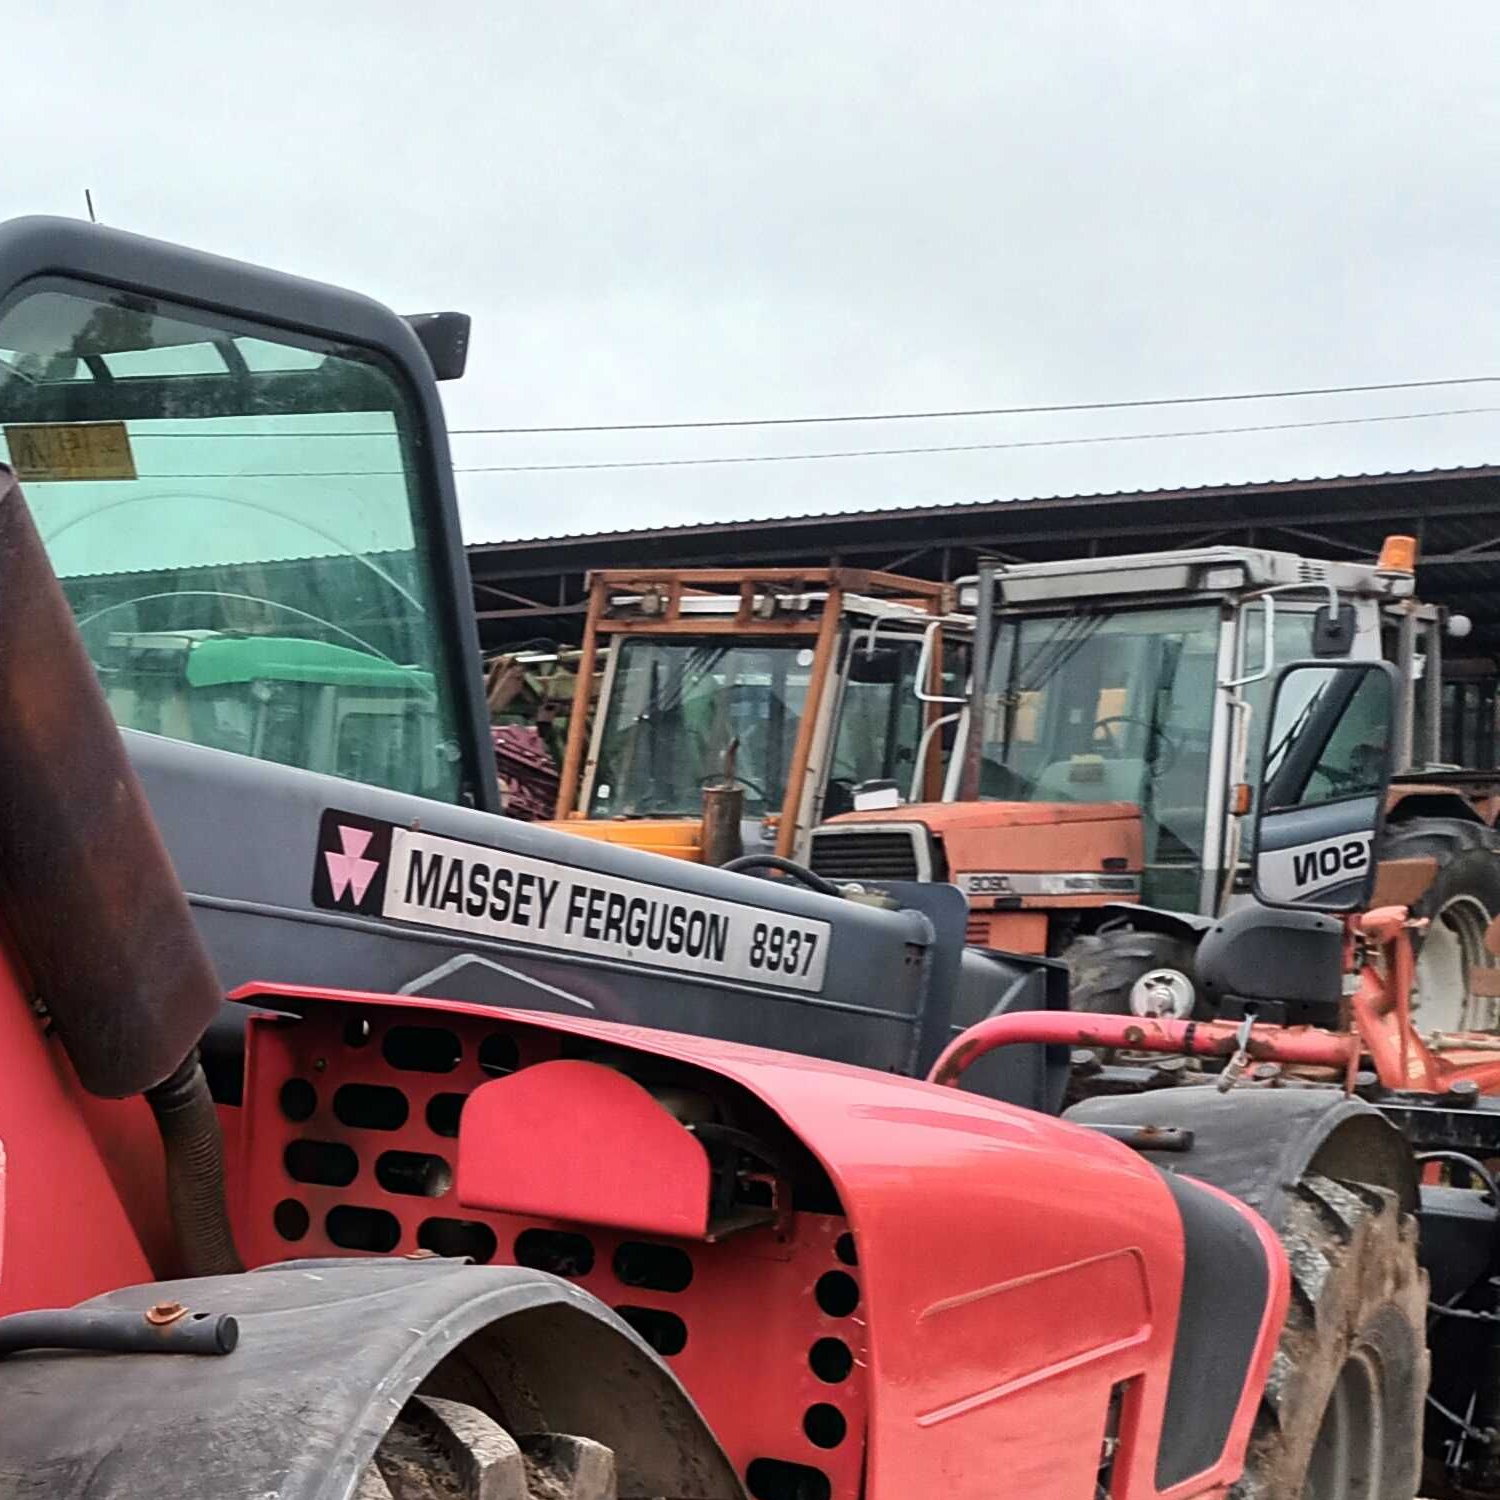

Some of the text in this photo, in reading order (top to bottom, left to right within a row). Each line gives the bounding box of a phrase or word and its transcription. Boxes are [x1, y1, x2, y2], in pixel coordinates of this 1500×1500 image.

[404, 850, 818, 977] MASSEY FERGUSON 8937
